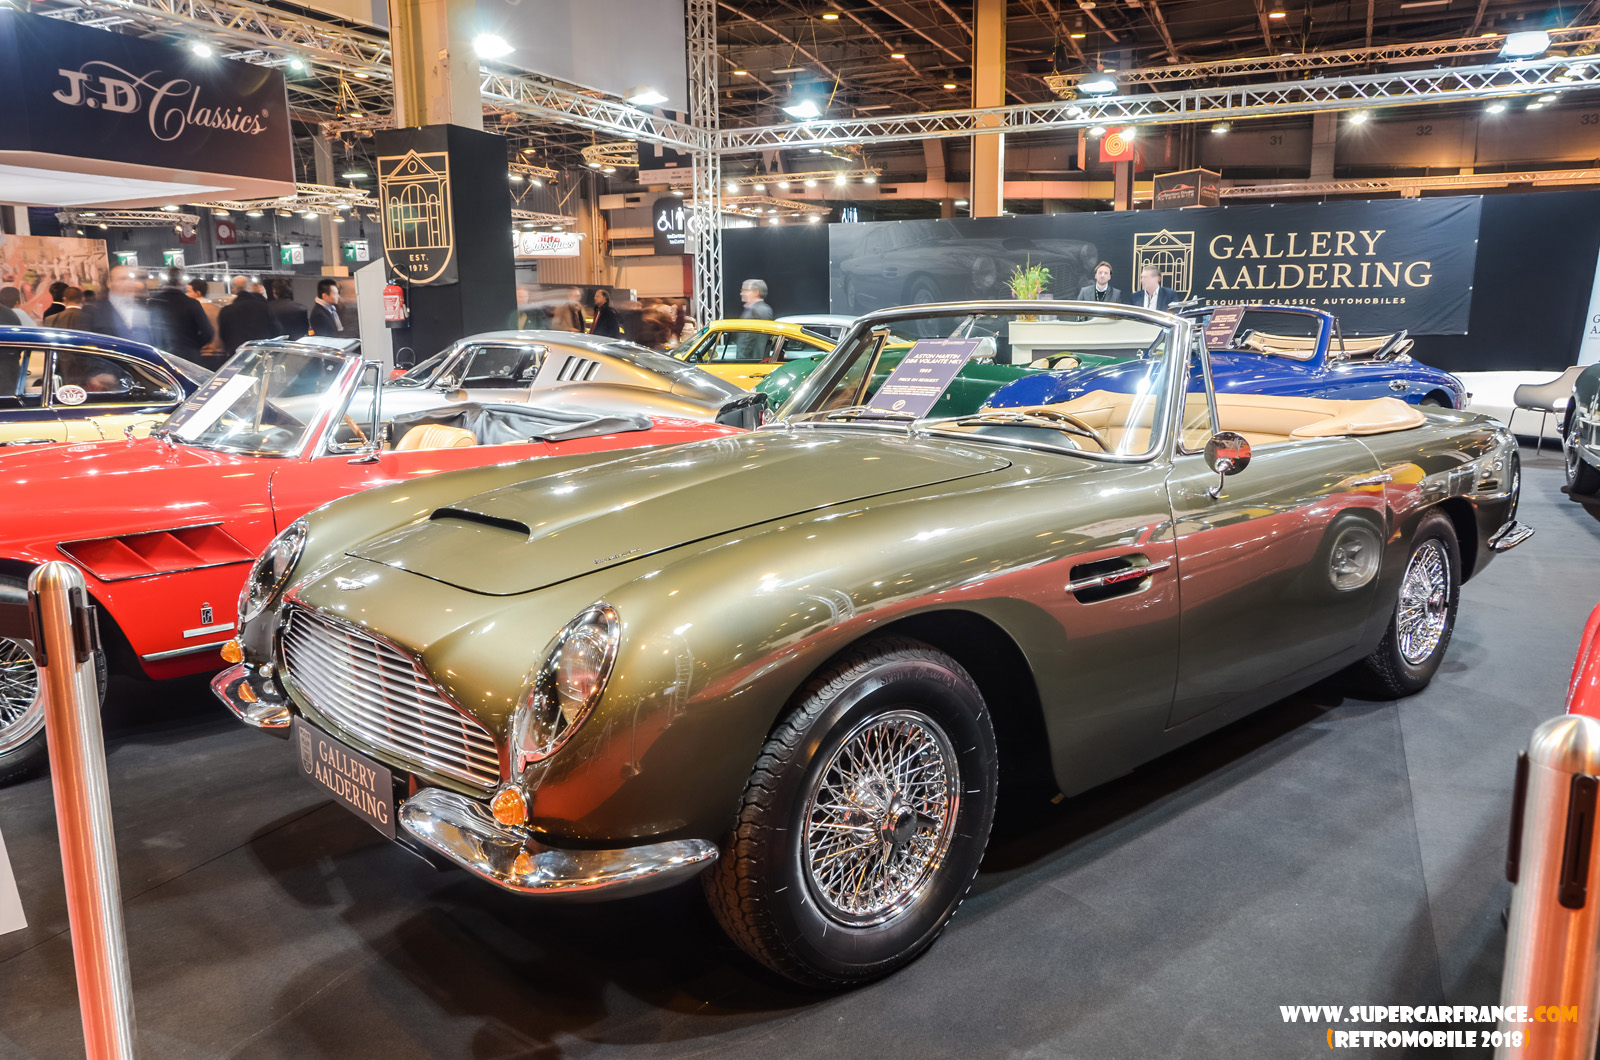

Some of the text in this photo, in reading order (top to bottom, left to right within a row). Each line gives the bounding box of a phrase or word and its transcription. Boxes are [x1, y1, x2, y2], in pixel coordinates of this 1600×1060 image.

[1581, 114, 1600, 126] 33
[1416, 125, 1433, 137] 32
[1269, 135, 1283, 146] 31
[1209, 230, 1386, 259] GALLERY
[409, 264, 429, 272] 1975
[1206, 261, 1432, 290] AALDERING
[1205, 298, 1264, 306] EXQUISITE
[1323, 297, 1406, 305] AUTOMOBILES
[318, 740, 377, 793] GALLERY
[315, 760, 389, 825] AALDERING
